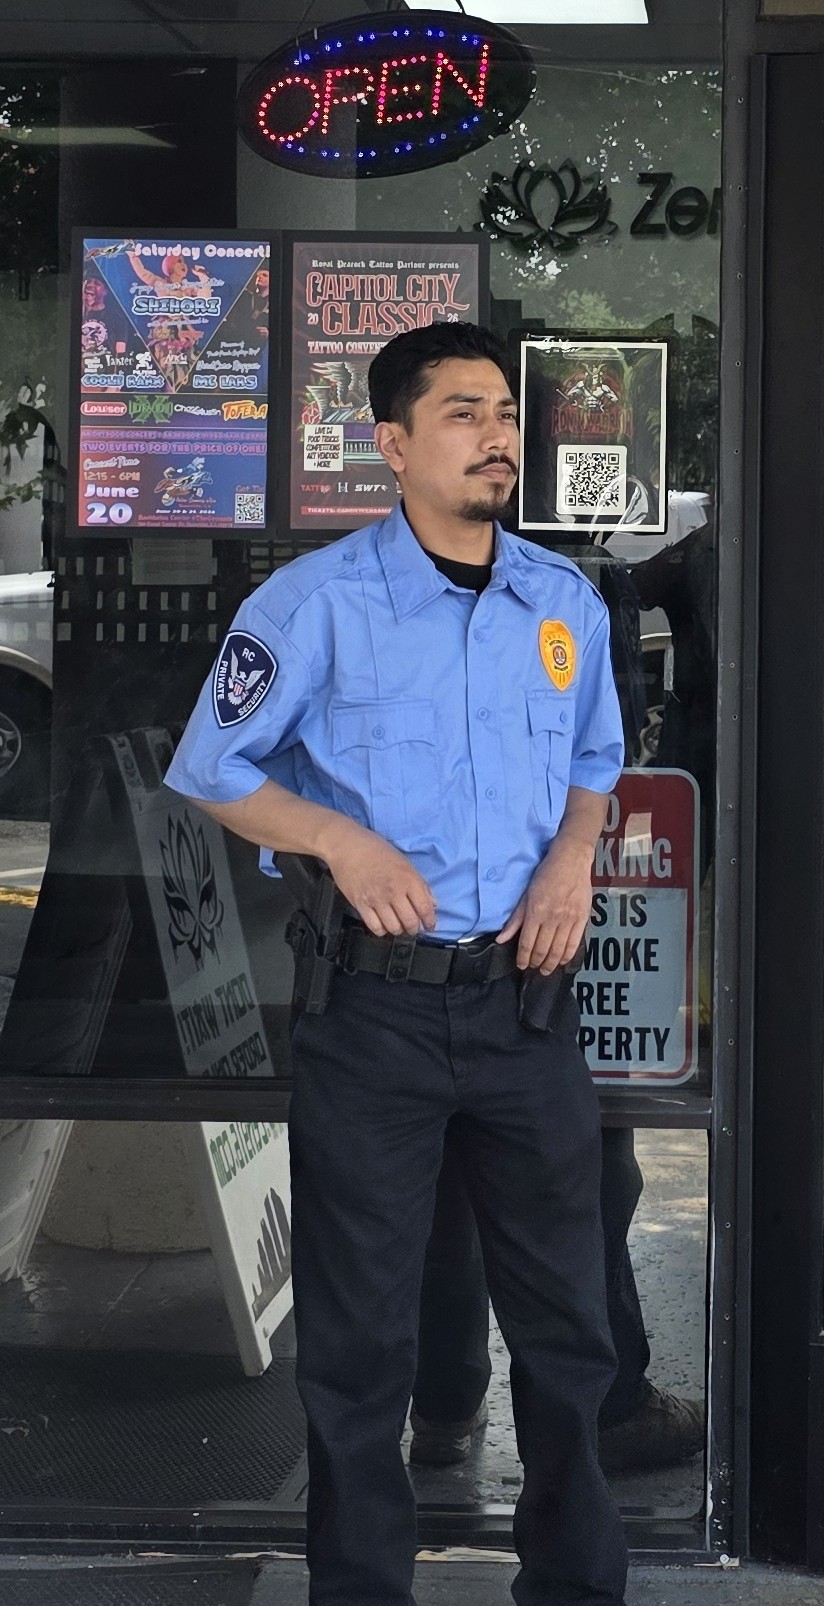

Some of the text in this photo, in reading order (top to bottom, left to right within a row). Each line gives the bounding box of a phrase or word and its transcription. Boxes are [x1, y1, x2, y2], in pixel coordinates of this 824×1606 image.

[259, 44, 489, 142] OPEN
[135, 243, 271, 260] Saturday Concert!
[312, 259, 459, 270] Royal Peacock Tattoo Parlour presents
[133, 297, 220, 315] SHIHORI
[306, 272, 470, 311] CAPITOL CITY
[307, 313, 319, 325] 20
[322, 302, 445, 336] CLASSIC
[307, 341, 343, 354] TATTOO
[193, 375, 257, 389] MC LARS
[82, 442, 105, 452] TWO
[109, 442, 146, 453] EVENTS
[149, 443, 169, 453] FOR
[172, 443, 190, 453] THE
[193, 443, 222, 453] PRICE
[225, 443, 239, 453] OF
[84, 484, 139, 498] June
[119, 472, 140, 481] 6PM
[86, 502, 133, 524] 20
[241, 647, 256, 662] RC
[217, 660, 228, 700] PRIVATE
[237, 680, 267, 716] SECURITY
[603, 793, 620, 833] O
[595, 837, 672, 879] KING
[619, 893, 647, 928] IS
[582, 937, 659, 972] MOKE
[576, 981, 630, 1016] REE
[577, 1026, 670, 1061] PERTY
